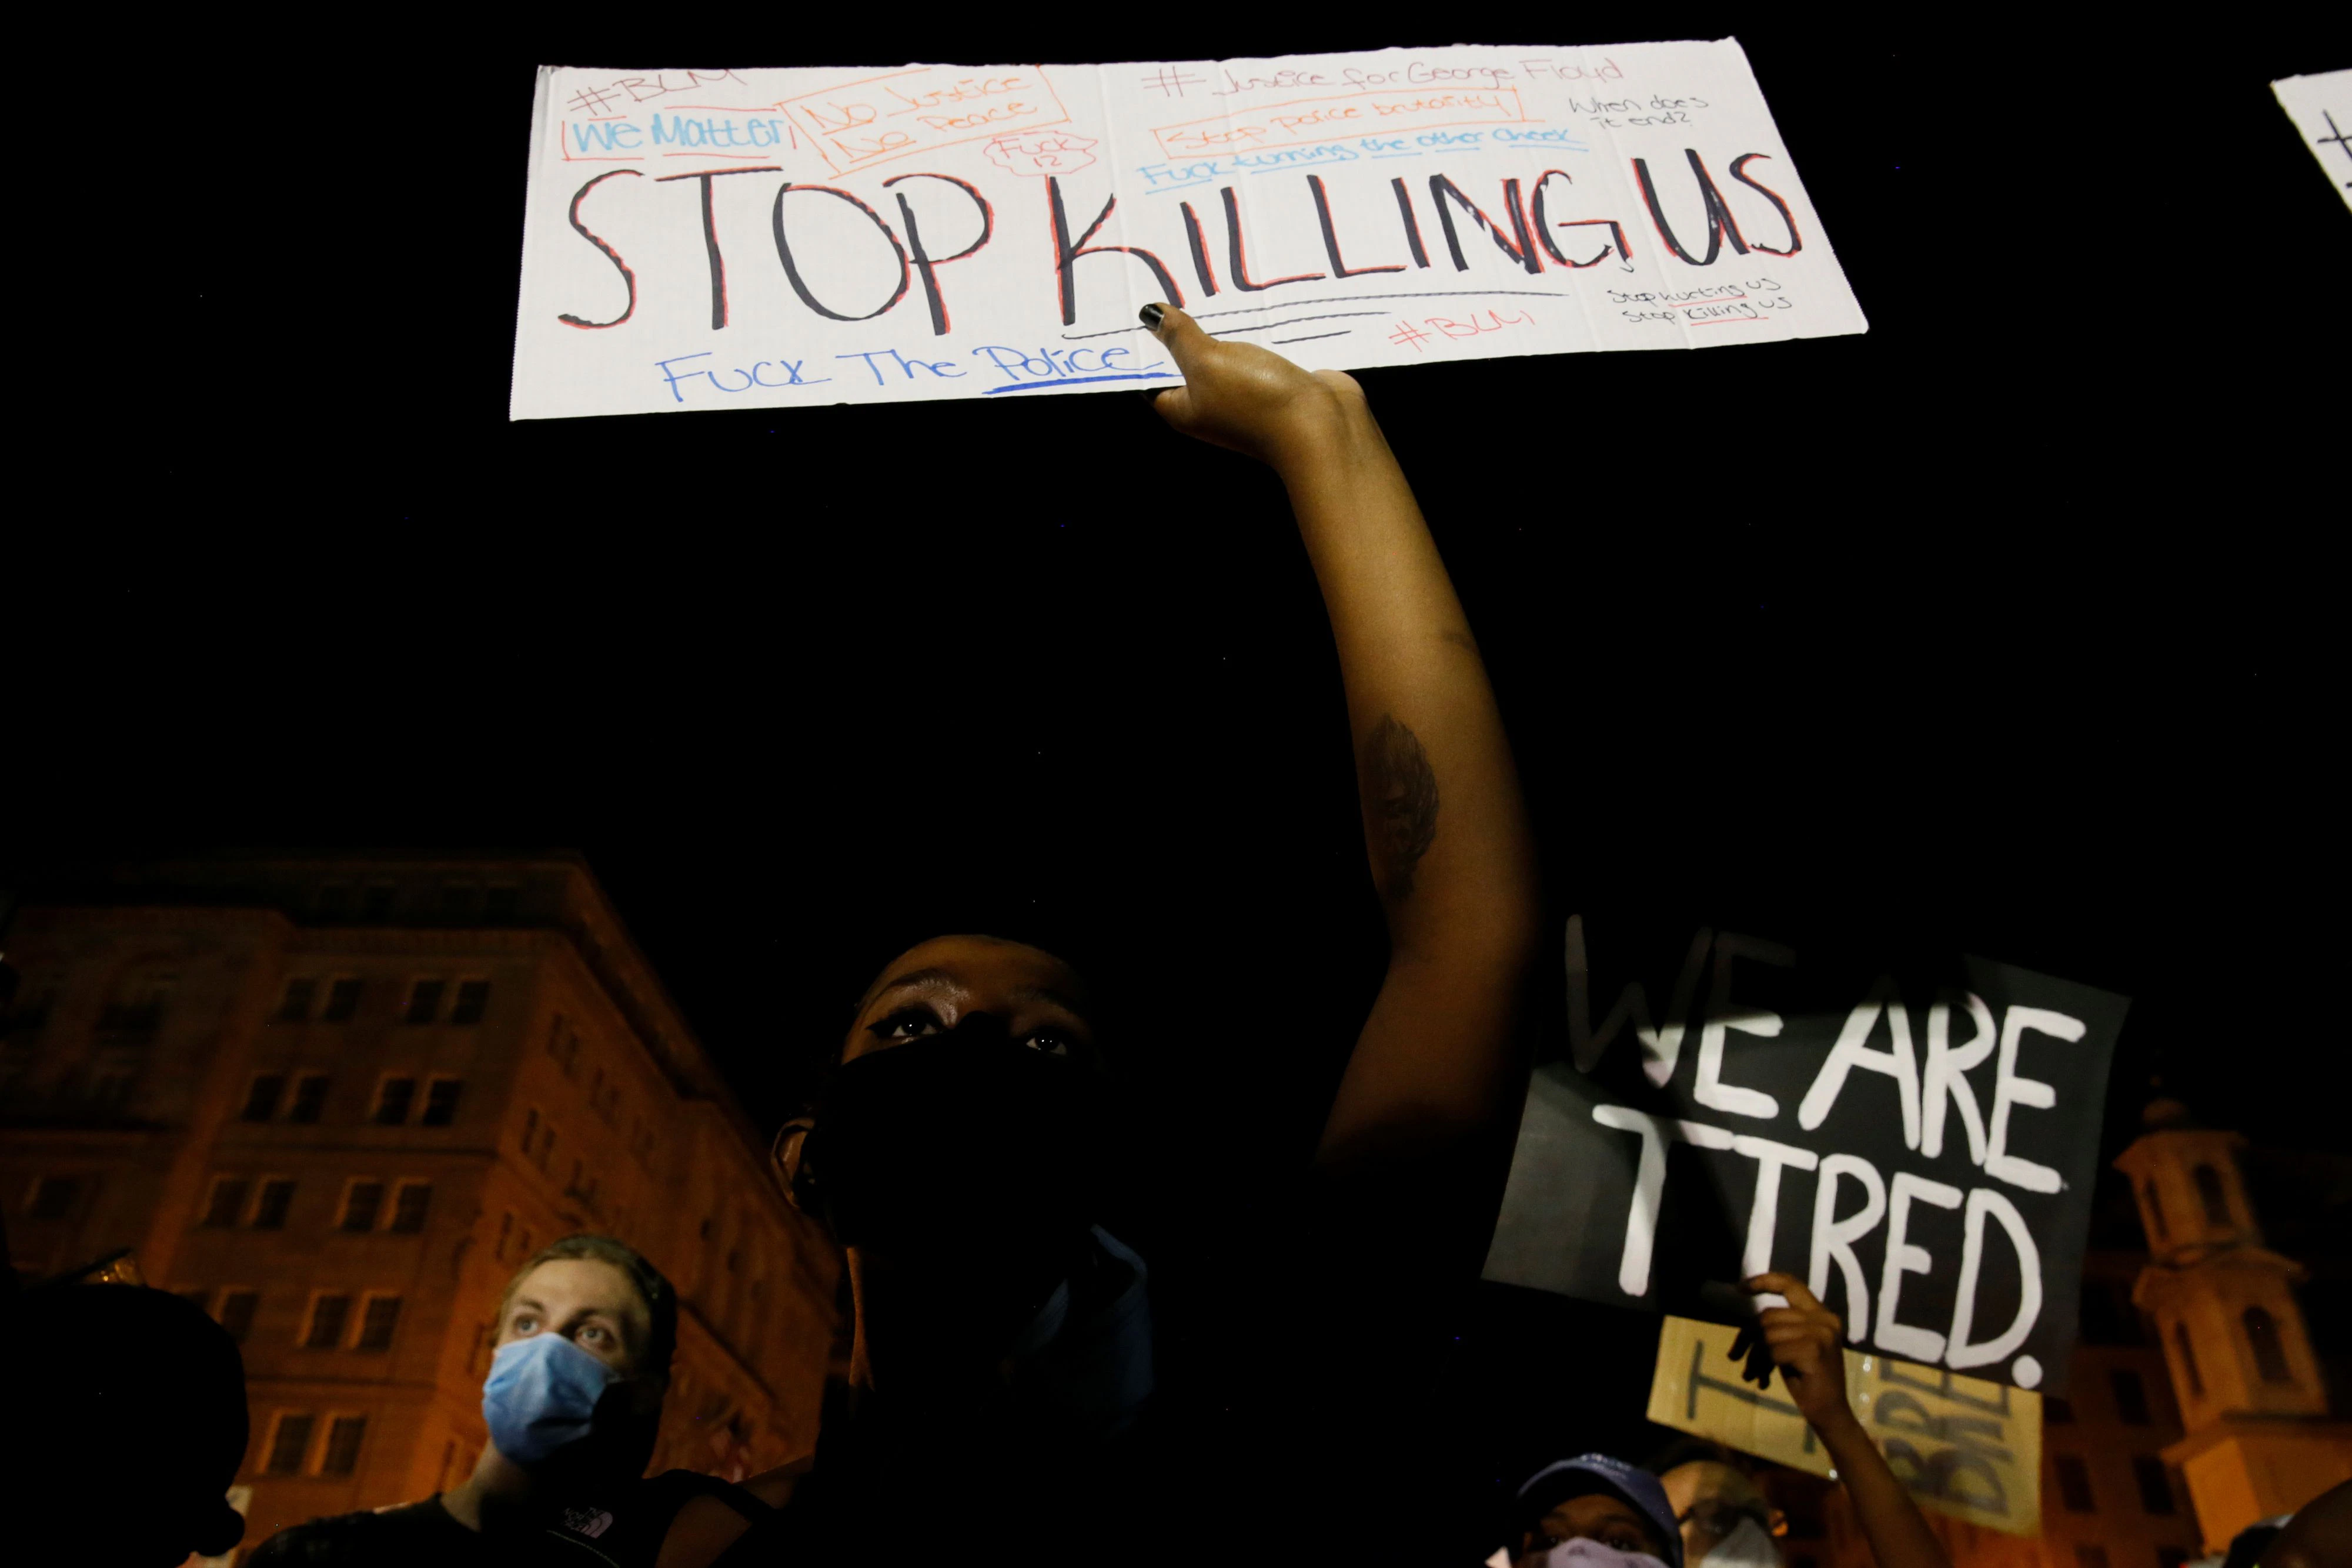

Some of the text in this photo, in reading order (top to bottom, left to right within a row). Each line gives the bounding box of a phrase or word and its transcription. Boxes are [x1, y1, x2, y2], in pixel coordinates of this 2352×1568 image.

[1518, 58, 1623, 83] Floyd
[884, 77, 1031, 116] Justice
[1651, 95, 1709, 109] does
[573, 113, 783, 152] We Matter
[1628, 111, 1693, 126] end?
[1361, 138, 1411, 151] the
[1416, 132, 1484, 146] other
[558, 148, 1802, 336] STOP KILLING US
[1389, 310, 1535, 352] #BLM
[835, 349, 967, 385] The
[972, 346, 1164, 380] Police
[1565, 914, 2086, 1193] WE ARE
[1592, 1104, 2042, 1389] TIRED.
